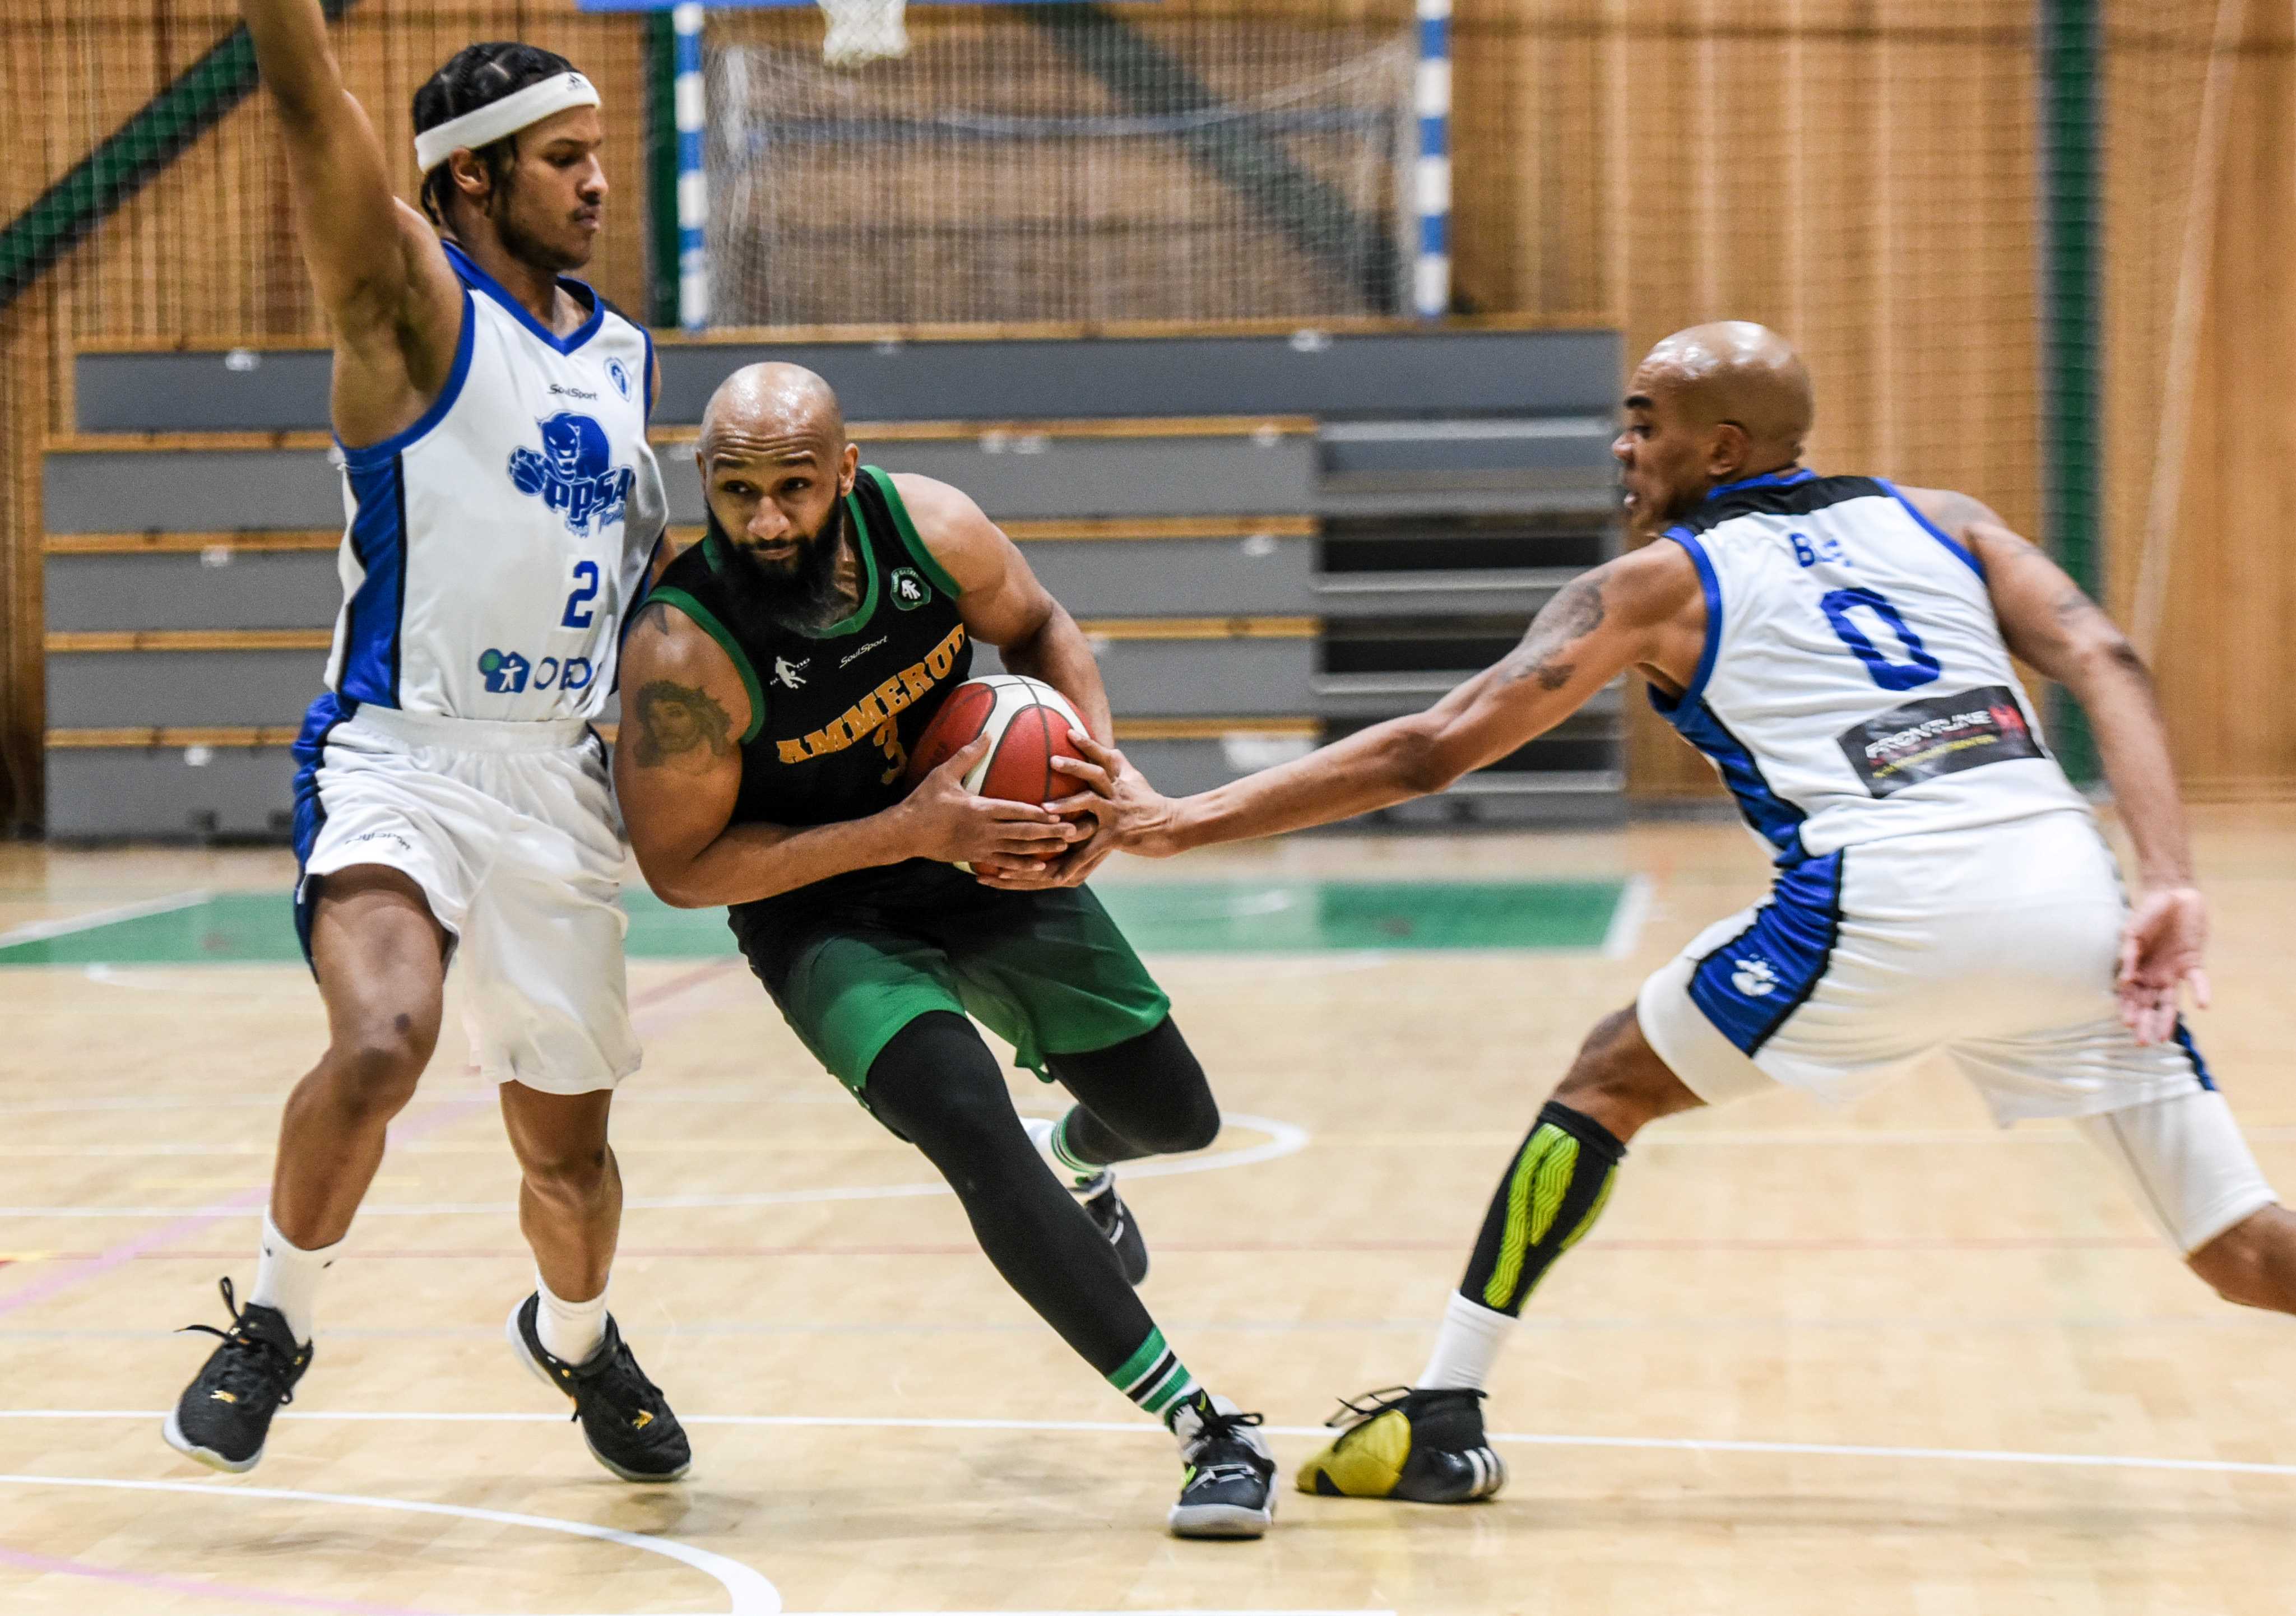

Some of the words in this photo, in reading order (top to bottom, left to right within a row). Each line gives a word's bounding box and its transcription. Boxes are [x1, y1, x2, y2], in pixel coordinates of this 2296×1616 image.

[560, 560, 599, 628] 2
[839, 635, 888, 668] SoulSport
[1820, 587, 1941, 691] 0
